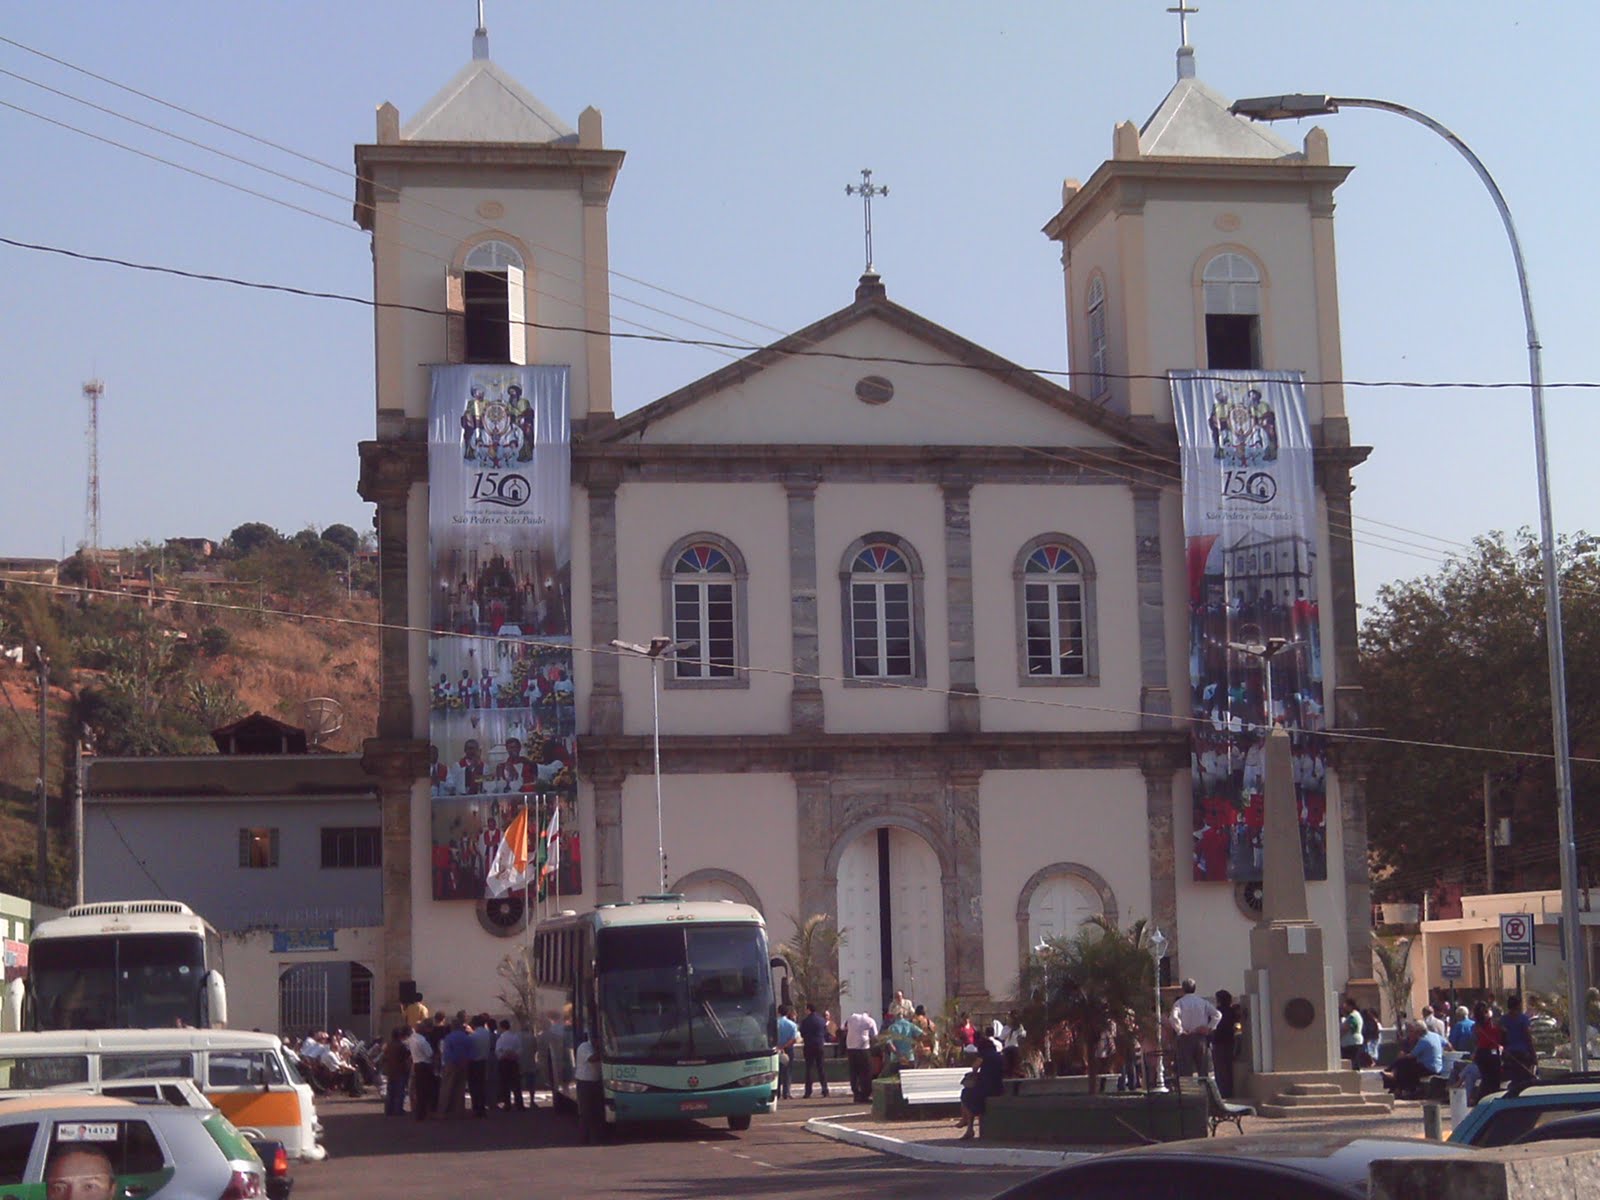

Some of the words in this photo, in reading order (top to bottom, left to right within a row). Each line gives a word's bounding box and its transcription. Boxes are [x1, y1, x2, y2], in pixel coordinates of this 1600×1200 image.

[469, 472, 532, 508] 150
[1220, 471, 1278, 504] 150
[452, 515, 468, 525] São
[470, 515, 494, 525] Pedro
[503, 515, 520, 525] São
[521, 515, 546, 525] Paulo
